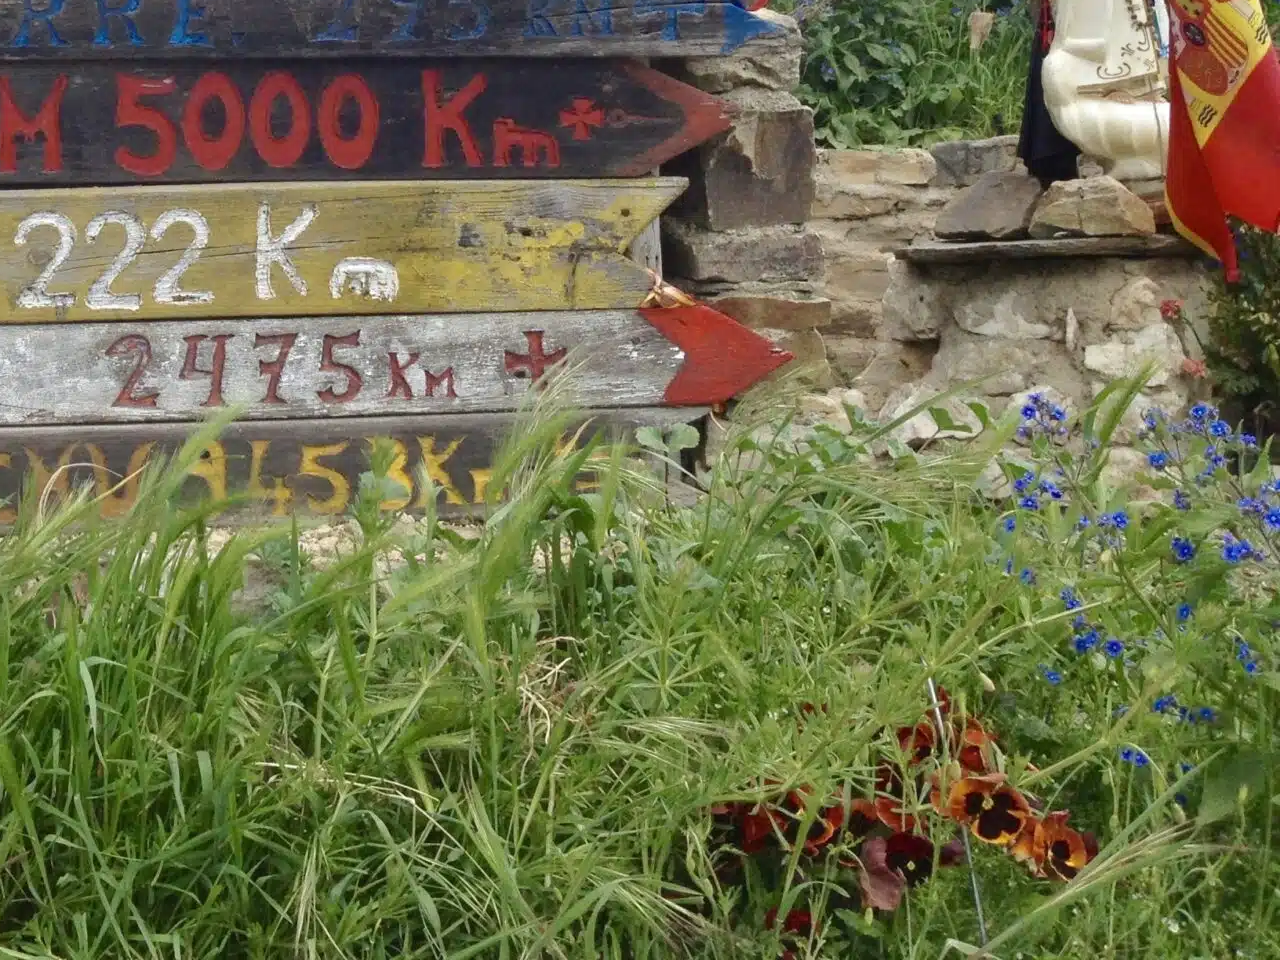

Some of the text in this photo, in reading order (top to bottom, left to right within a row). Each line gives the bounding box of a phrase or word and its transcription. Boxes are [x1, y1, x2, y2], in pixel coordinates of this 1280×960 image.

[115, 71, 380, 176] 5000
[15, 208, 216, 311] 222
[105, 329, 363, 408] 2475
